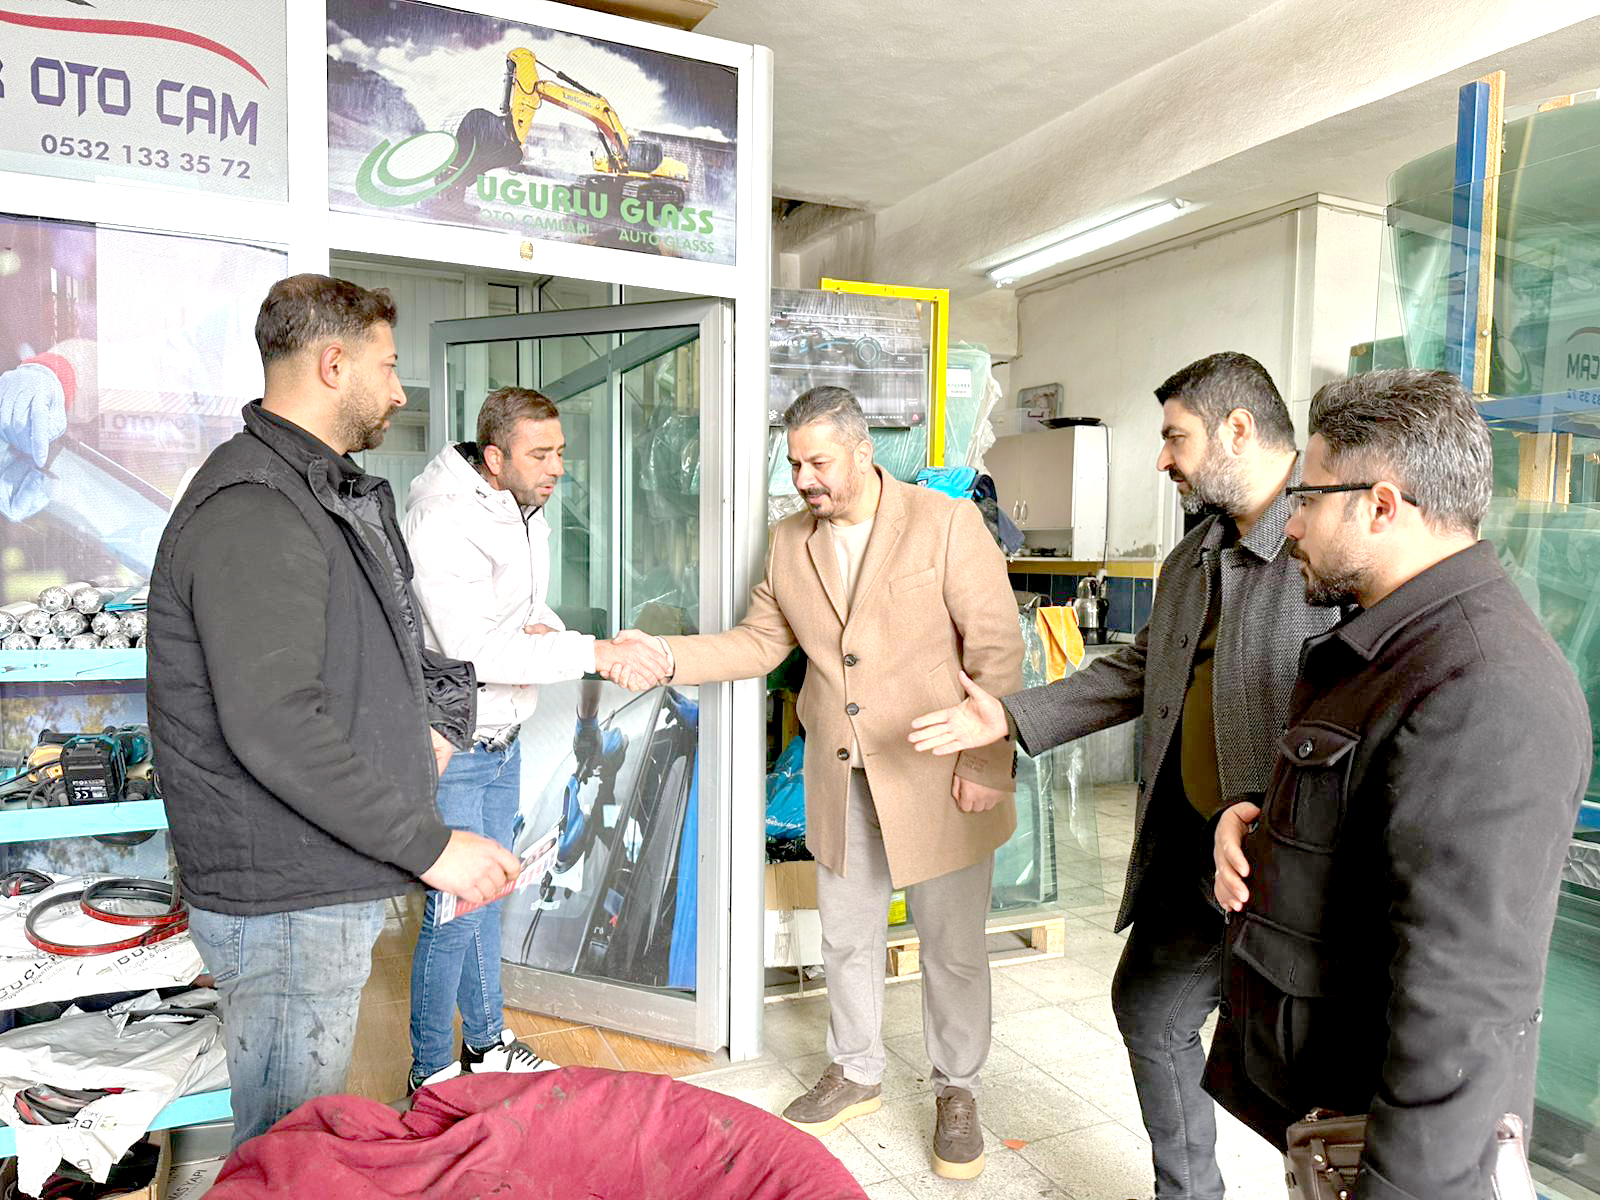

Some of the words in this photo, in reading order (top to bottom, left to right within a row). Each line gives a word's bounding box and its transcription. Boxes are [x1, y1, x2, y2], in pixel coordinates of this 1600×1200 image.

[31, 57, 131, 117] OTO
[156, 79, 259, 147] CAM
[41, 134, 110, 161] 0532
[122, 145, 170, 169] 133
[180, 152, 211, 174] 35
[221, 158, 251, 179] 72
[481, 208, 514, 222] OTO
[621, 197, 714, 235] GLASS
[619, 228, 660, 246] AUTO
[664, 235, 715, 253] GLASSS
